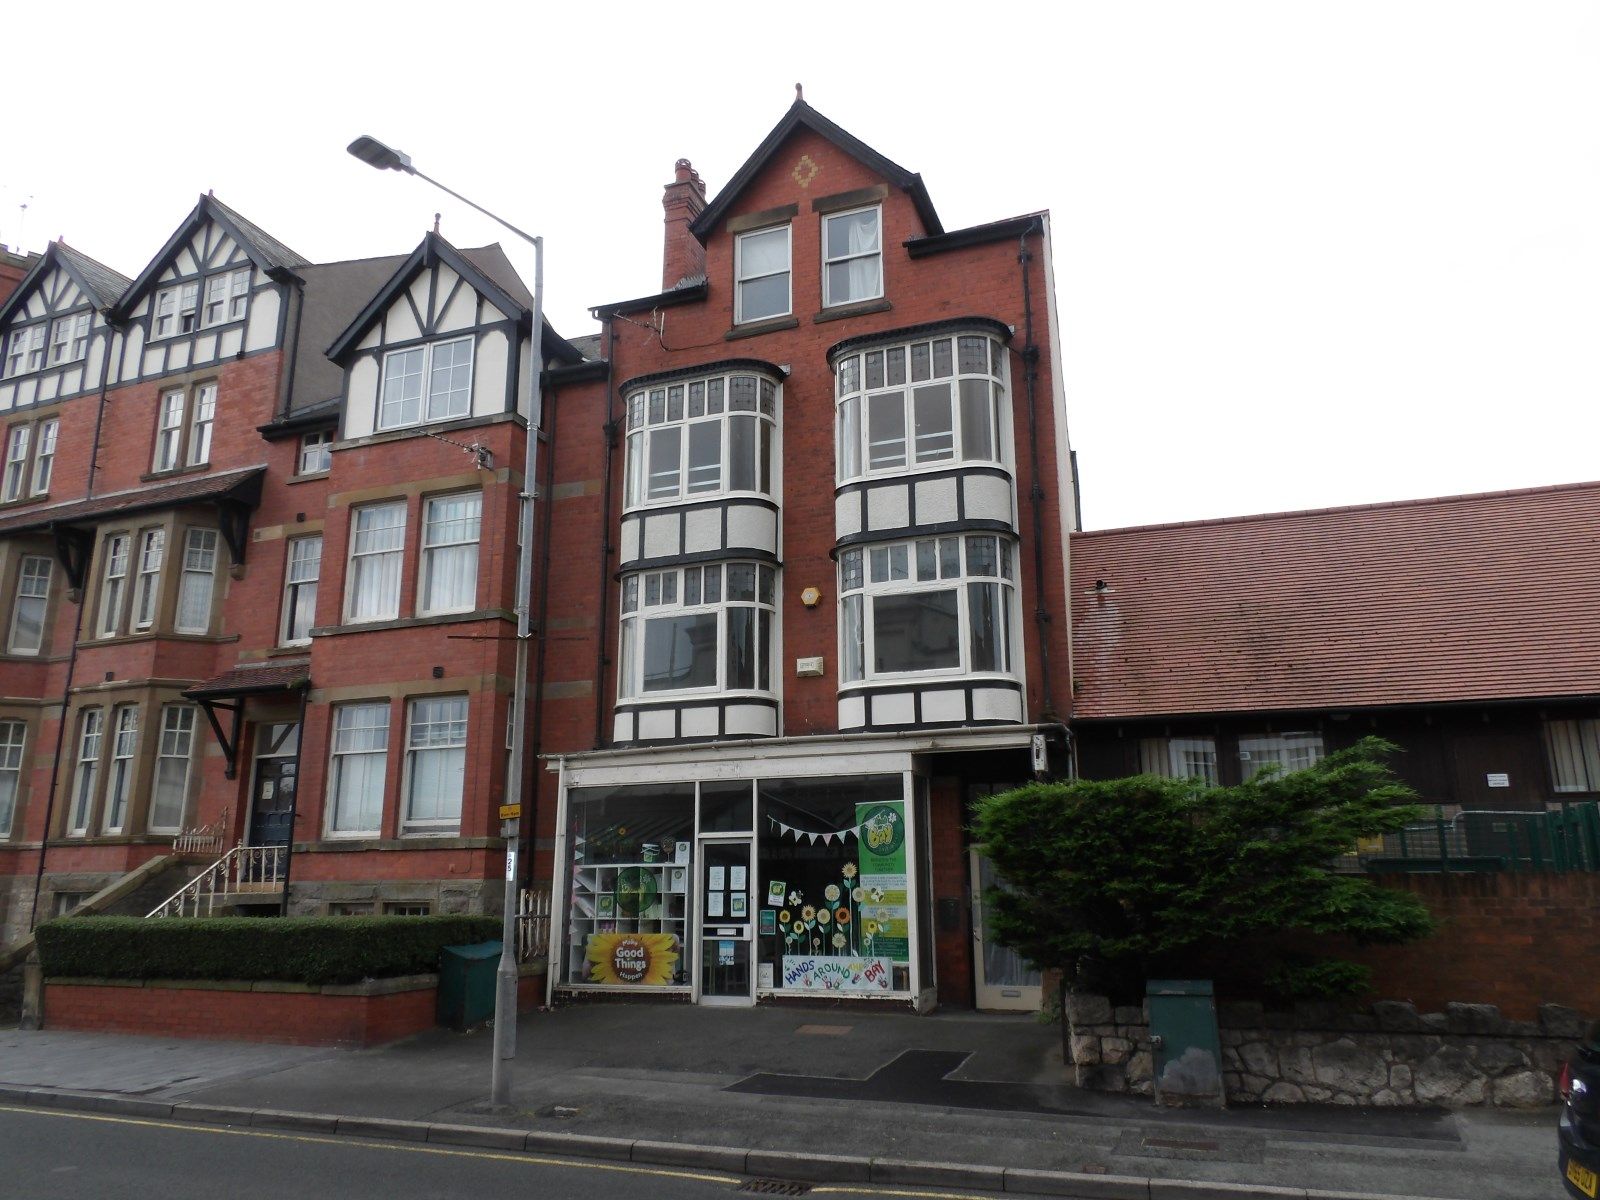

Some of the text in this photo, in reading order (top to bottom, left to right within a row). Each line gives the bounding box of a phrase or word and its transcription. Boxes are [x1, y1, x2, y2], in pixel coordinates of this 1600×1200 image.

[616, 947, 644, 958] Good
[614, 958, 646, 971] Things
[620, 971, 643, 980] Happen
[785, 960, 815, 985] HANDS
[813, 963, 851, 981] AROUND
[864, 960, 885, 983] BAY
